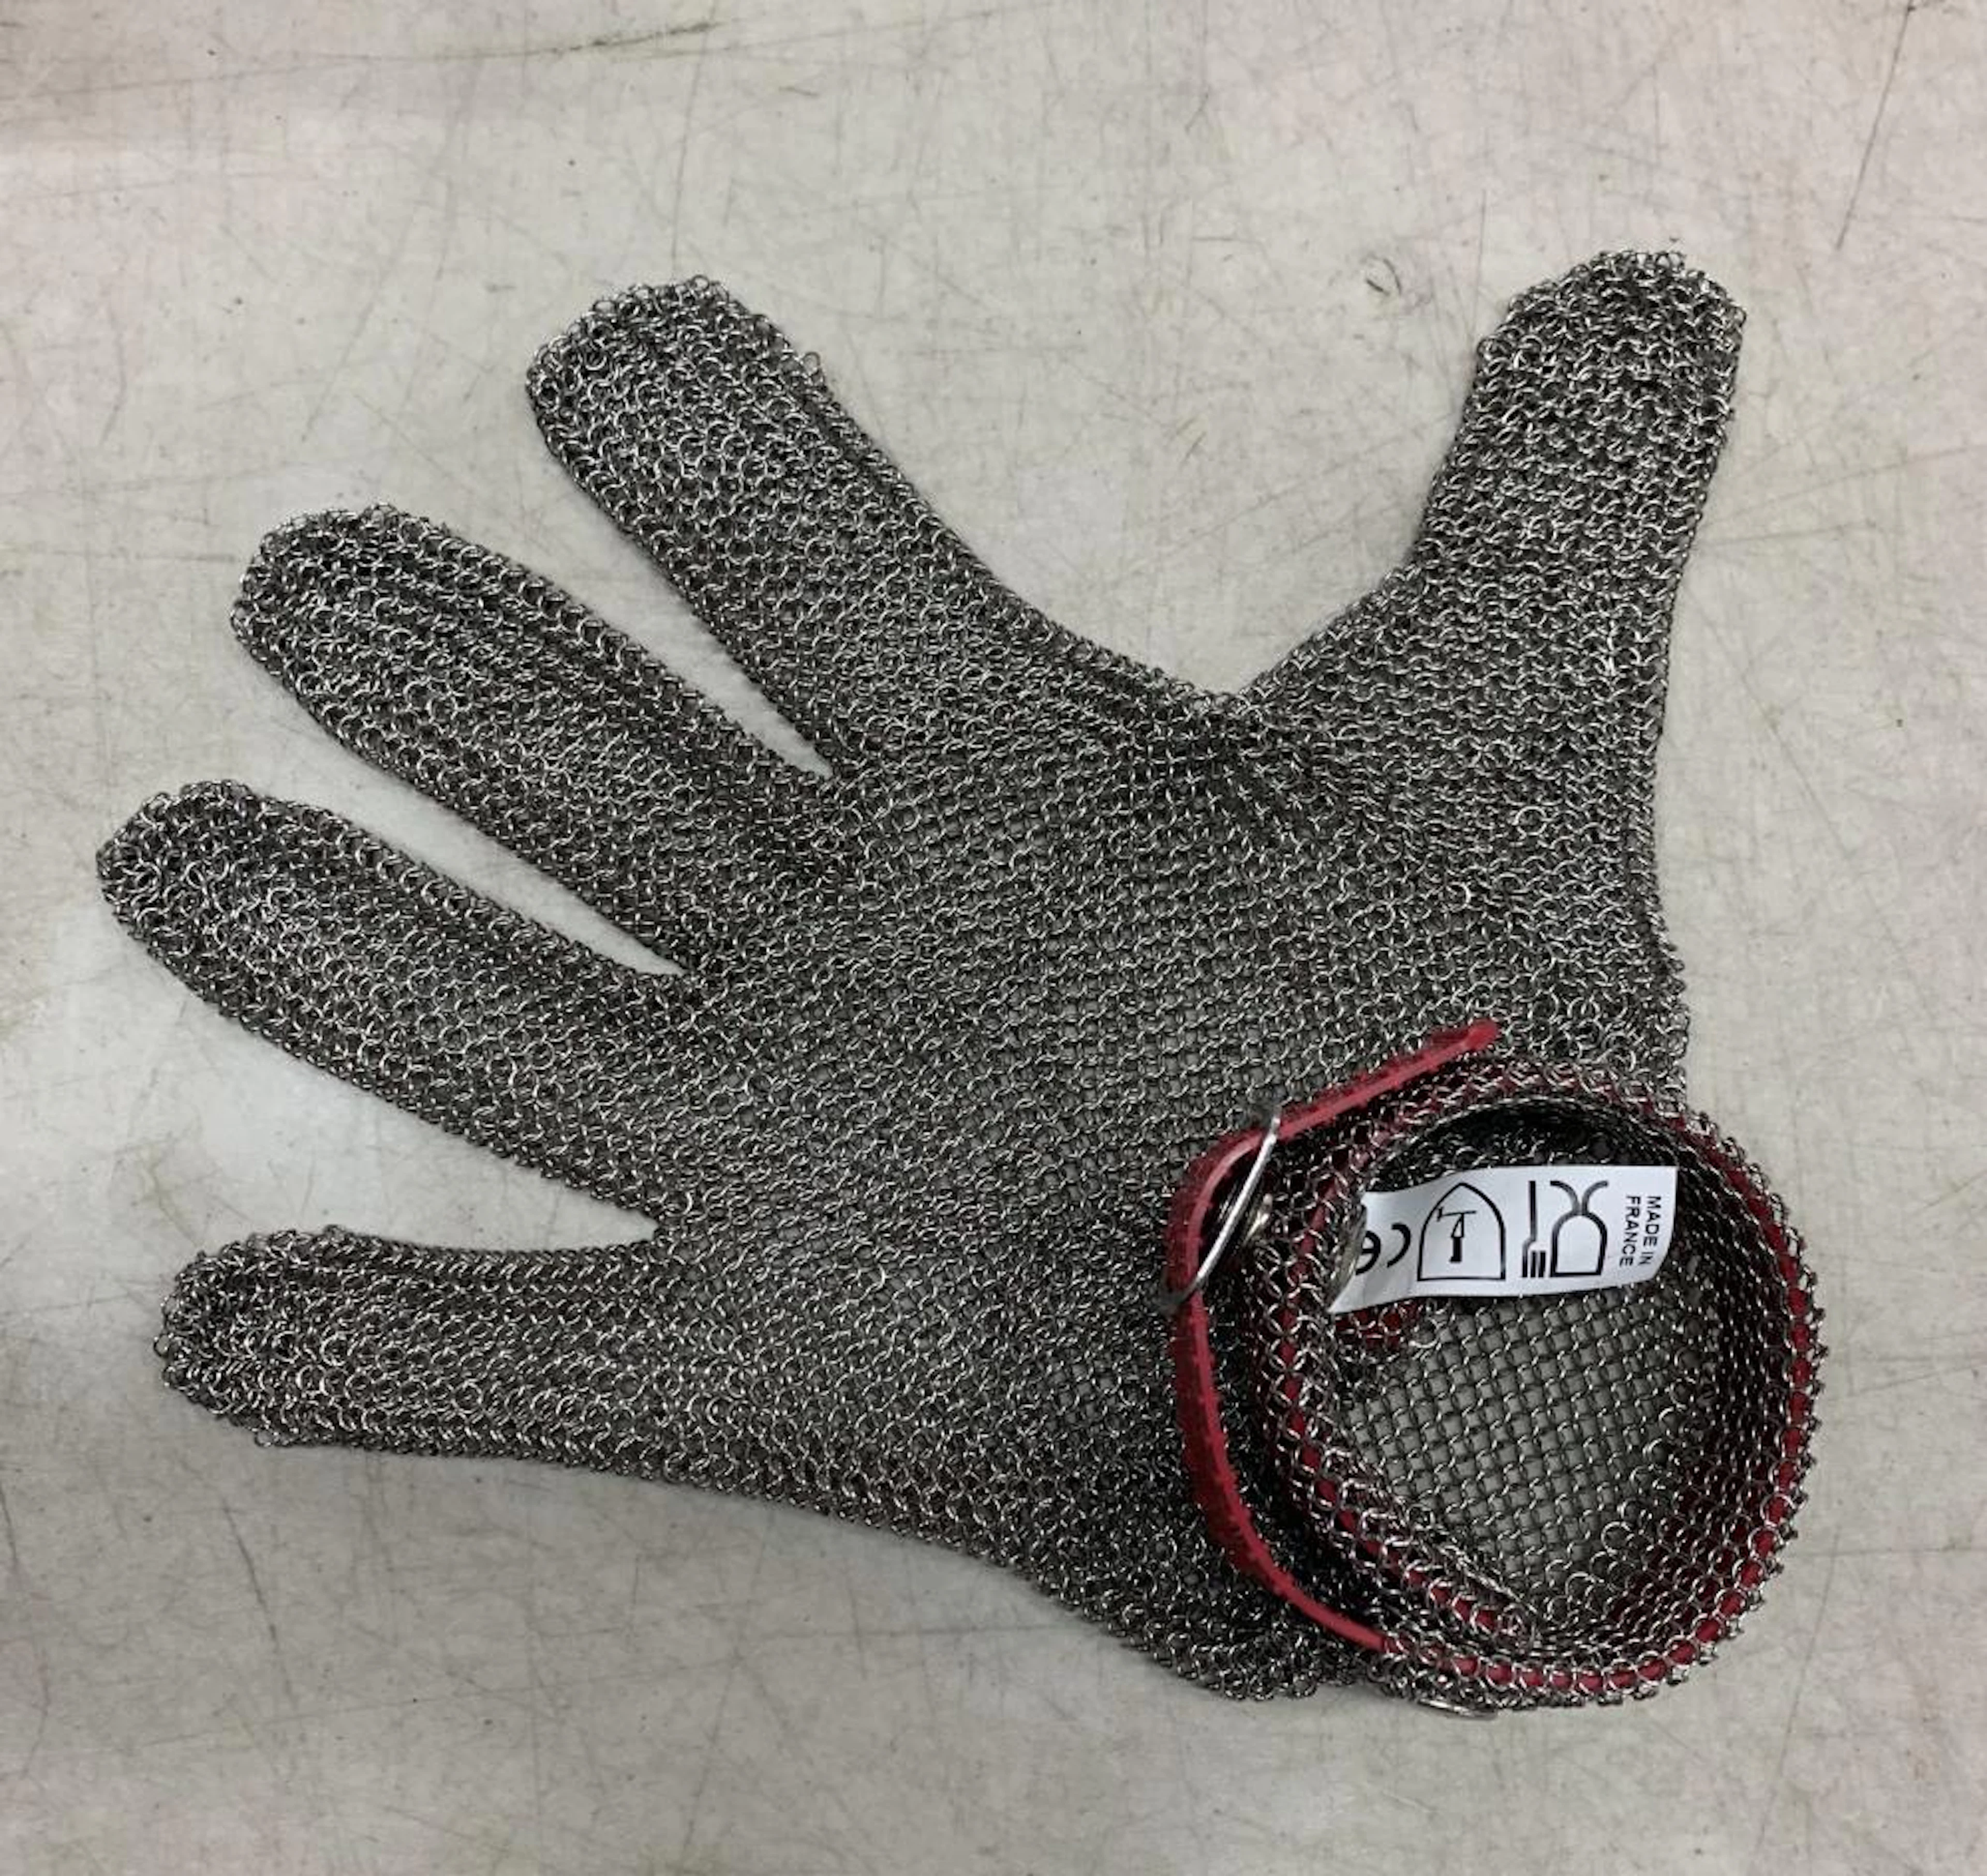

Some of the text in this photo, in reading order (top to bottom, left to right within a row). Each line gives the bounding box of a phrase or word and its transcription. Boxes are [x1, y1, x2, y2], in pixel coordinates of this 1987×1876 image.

[1619, 1195, 1641, 1267] FRANCE
[1638, 1195, 1662, 1266] MADE IN
